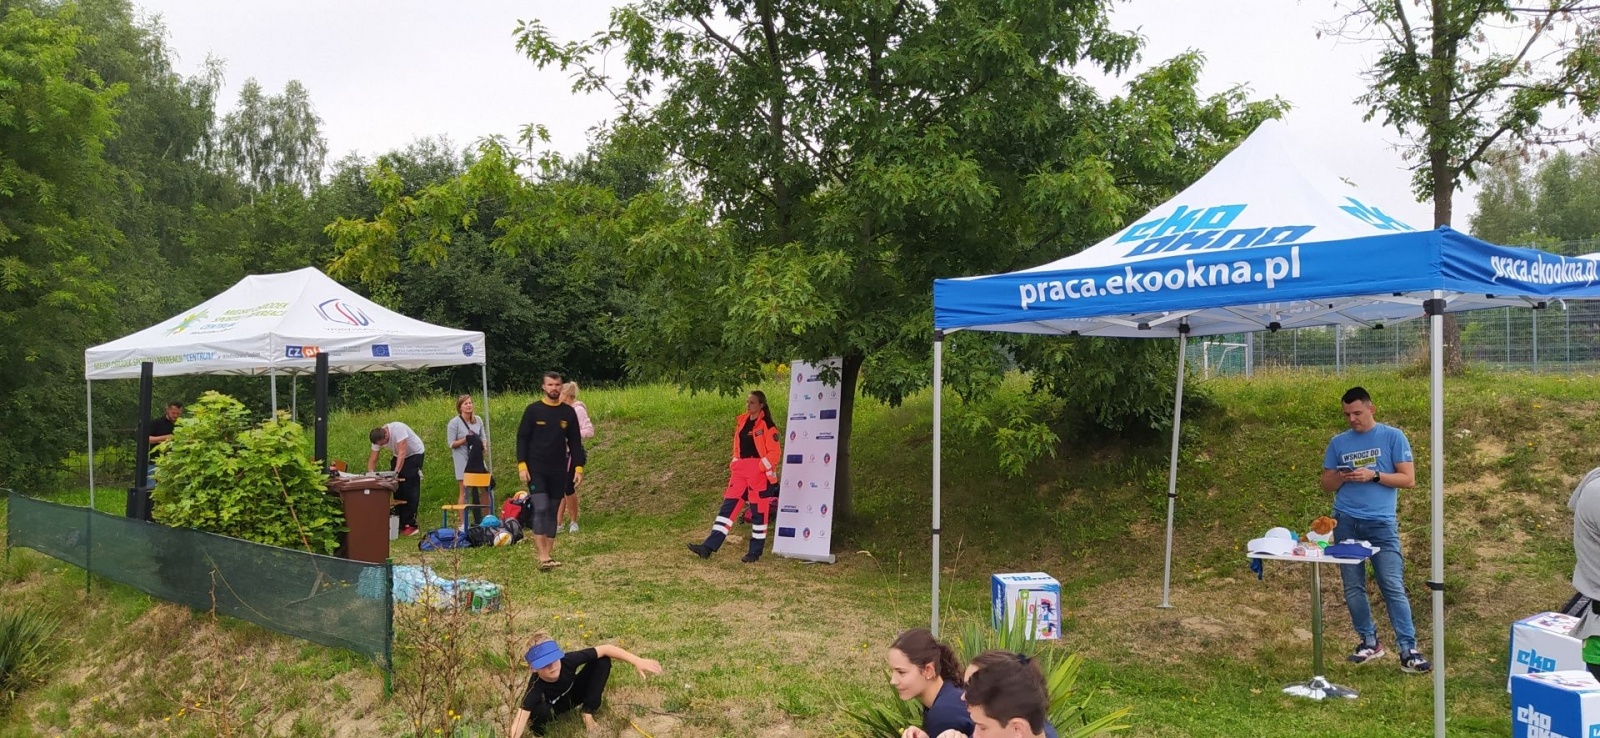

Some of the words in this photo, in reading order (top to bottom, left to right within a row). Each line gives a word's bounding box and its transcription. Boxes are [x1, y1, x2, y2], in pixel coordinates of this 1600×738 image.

[1114, 204, 1248, 245] eko
[1123, 225, 1316, 258] okna
[1019, 246, 1302, 310] praca.ekookna.pl
[1490, 254, 1599, 287] praca.ekookna.pl
[1344, 451, 1369, 462] WSKOCZ
[1371, 449, 1380, 457] DO
[1517, 648, 1556, 672] eko
[1517, 703, 1552, 731] eko
